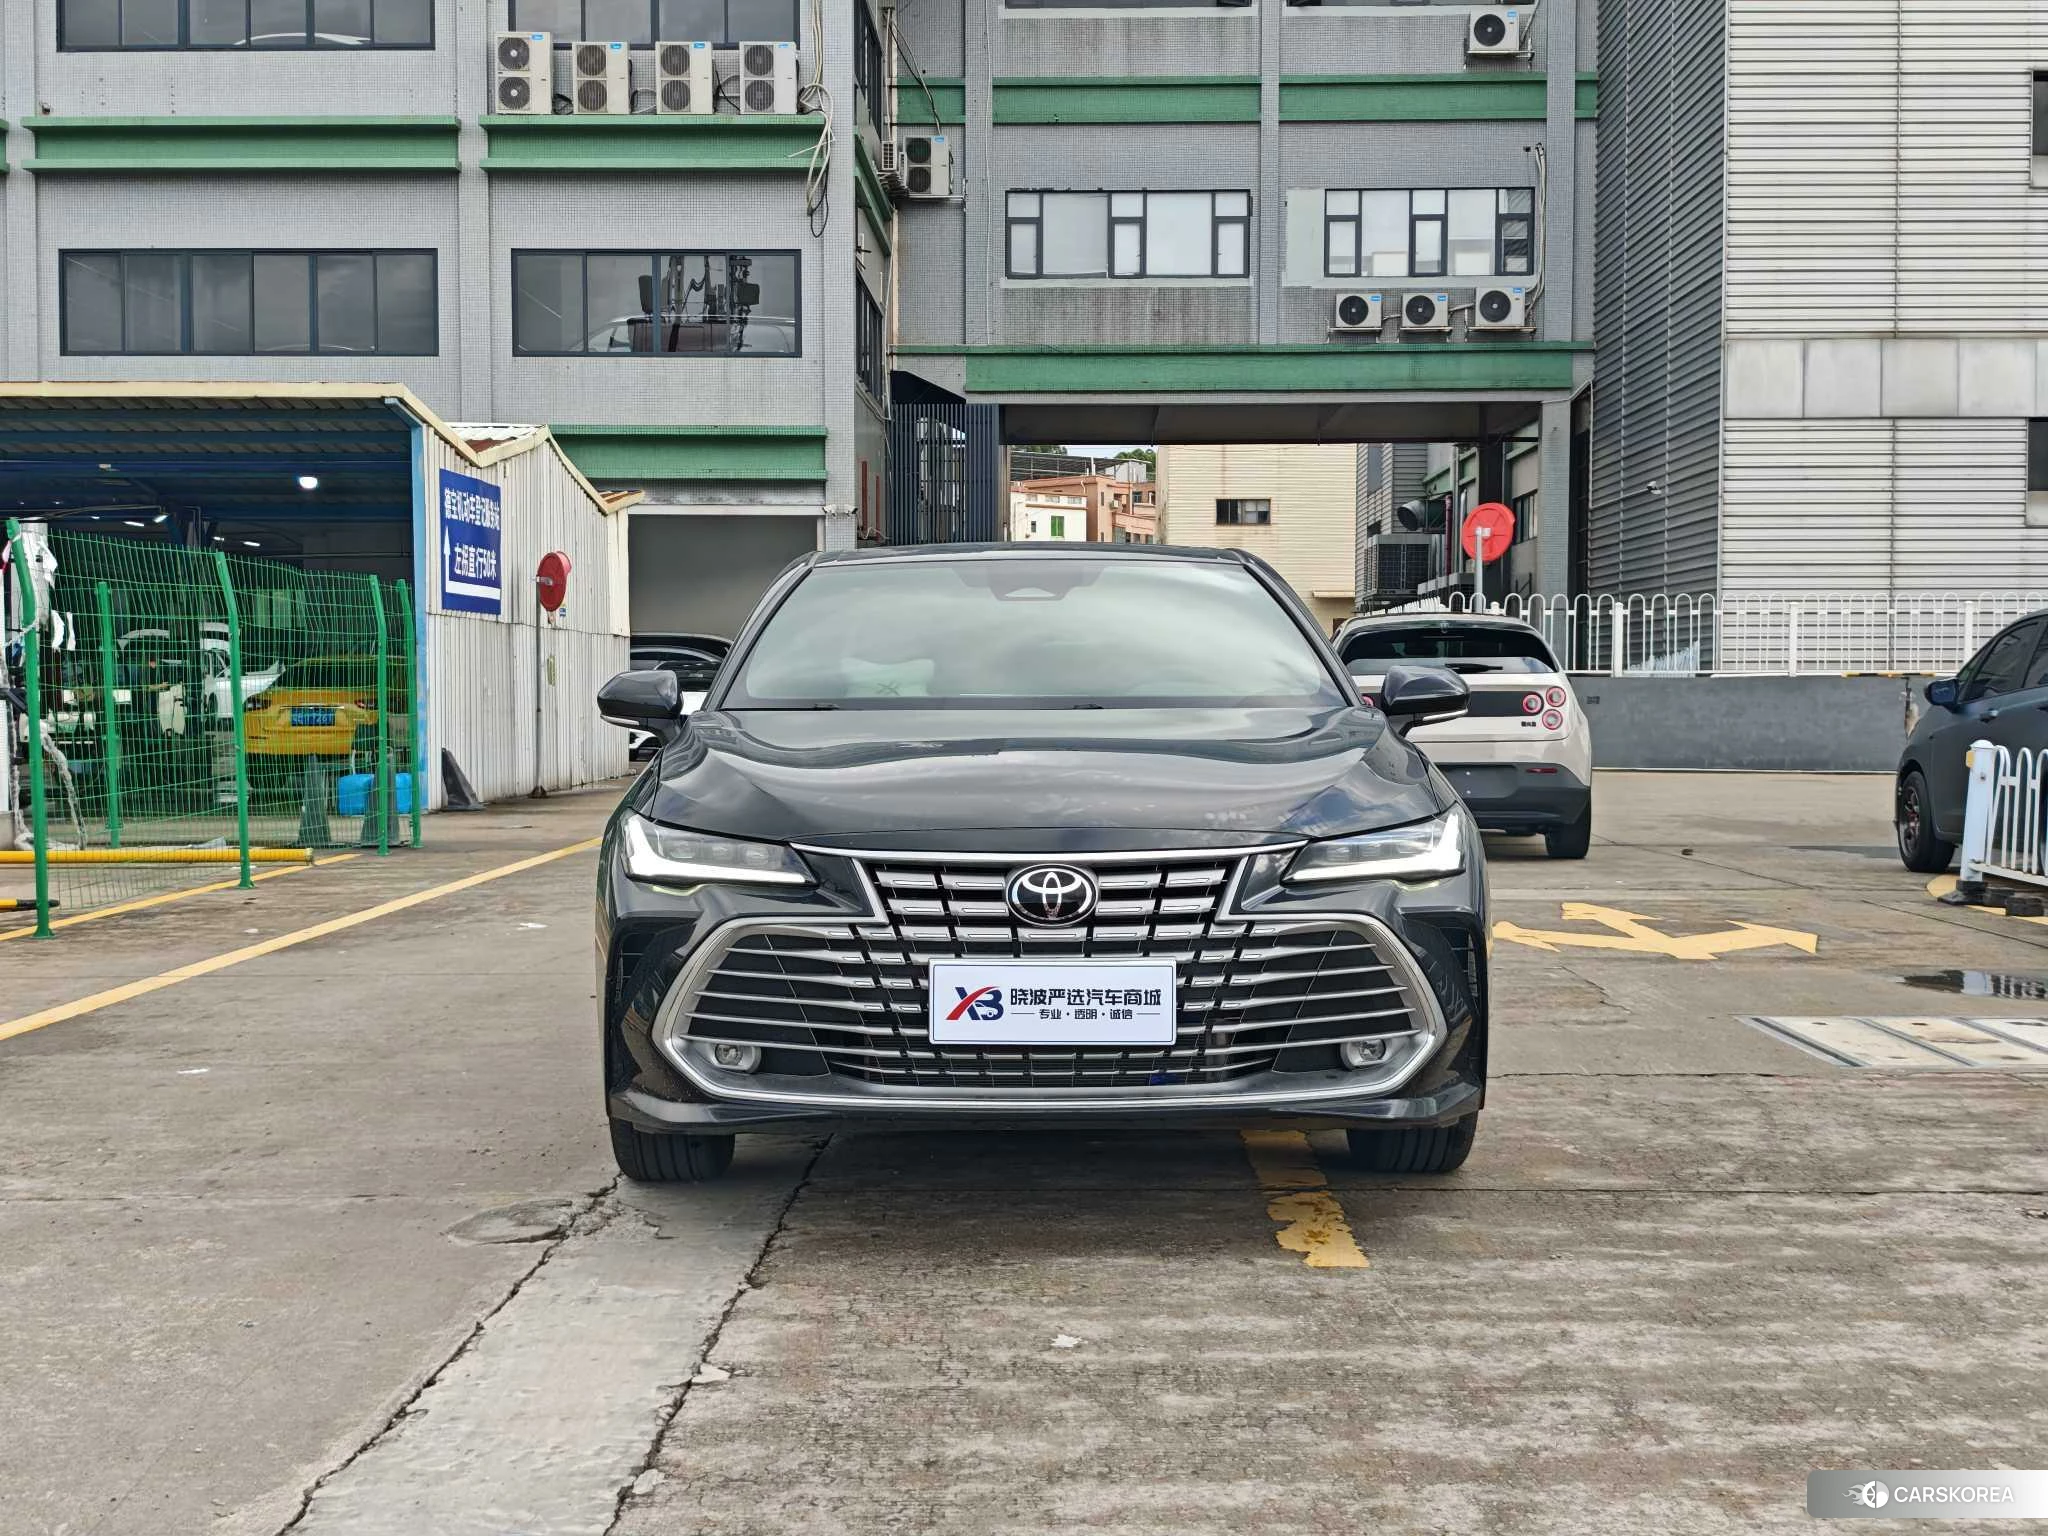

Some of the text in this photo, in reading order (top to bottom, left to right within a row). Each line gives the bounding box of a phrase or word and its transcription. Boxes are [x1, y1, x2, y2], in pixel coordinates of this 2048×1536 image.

[1010, 988, 1161, 1006] 晓波严选汽车商城
